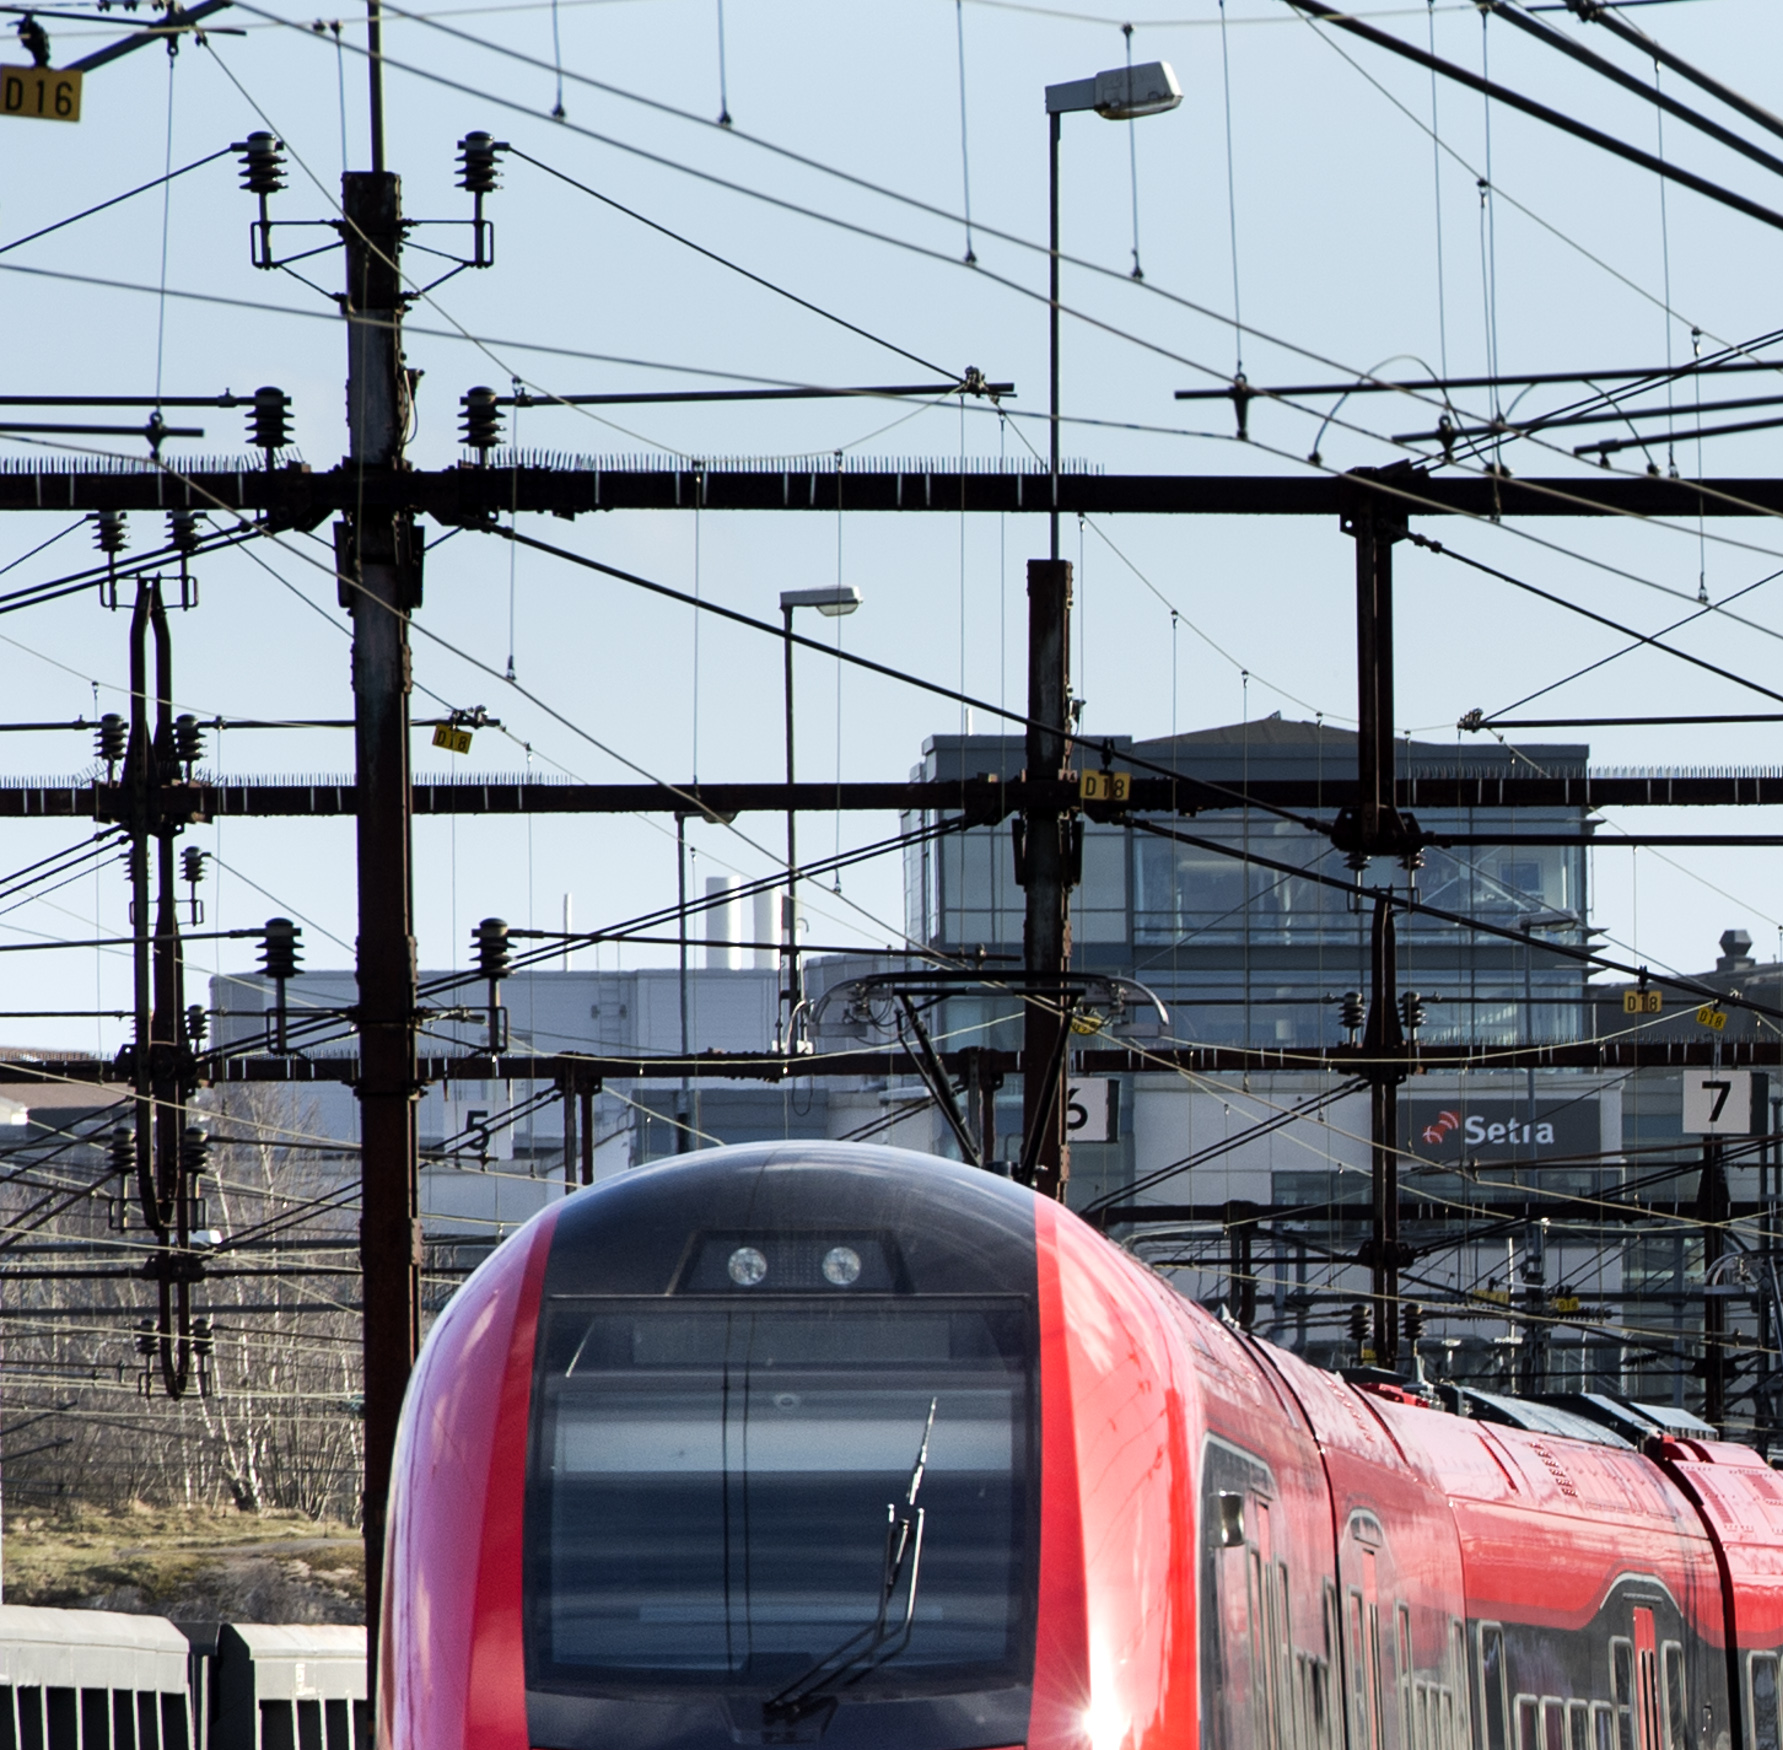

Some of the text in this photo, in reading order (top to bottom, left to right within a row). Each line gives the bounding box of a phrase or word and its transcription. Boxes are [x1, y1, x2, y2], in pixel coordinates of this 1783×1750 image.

[5, 76, 73, 116] D16
[437, 729, 467, 751] D18
[1086, 775, 1125, 799] D18
[1628, 995, 1659, 1012] D18
[1699, 1010, 1725, 1029] D18
[1067, 1088, 1089, 1131] 6
[1702, 1081, 1732, 1122] 7
[466, 1110, 491, 1151] 5
